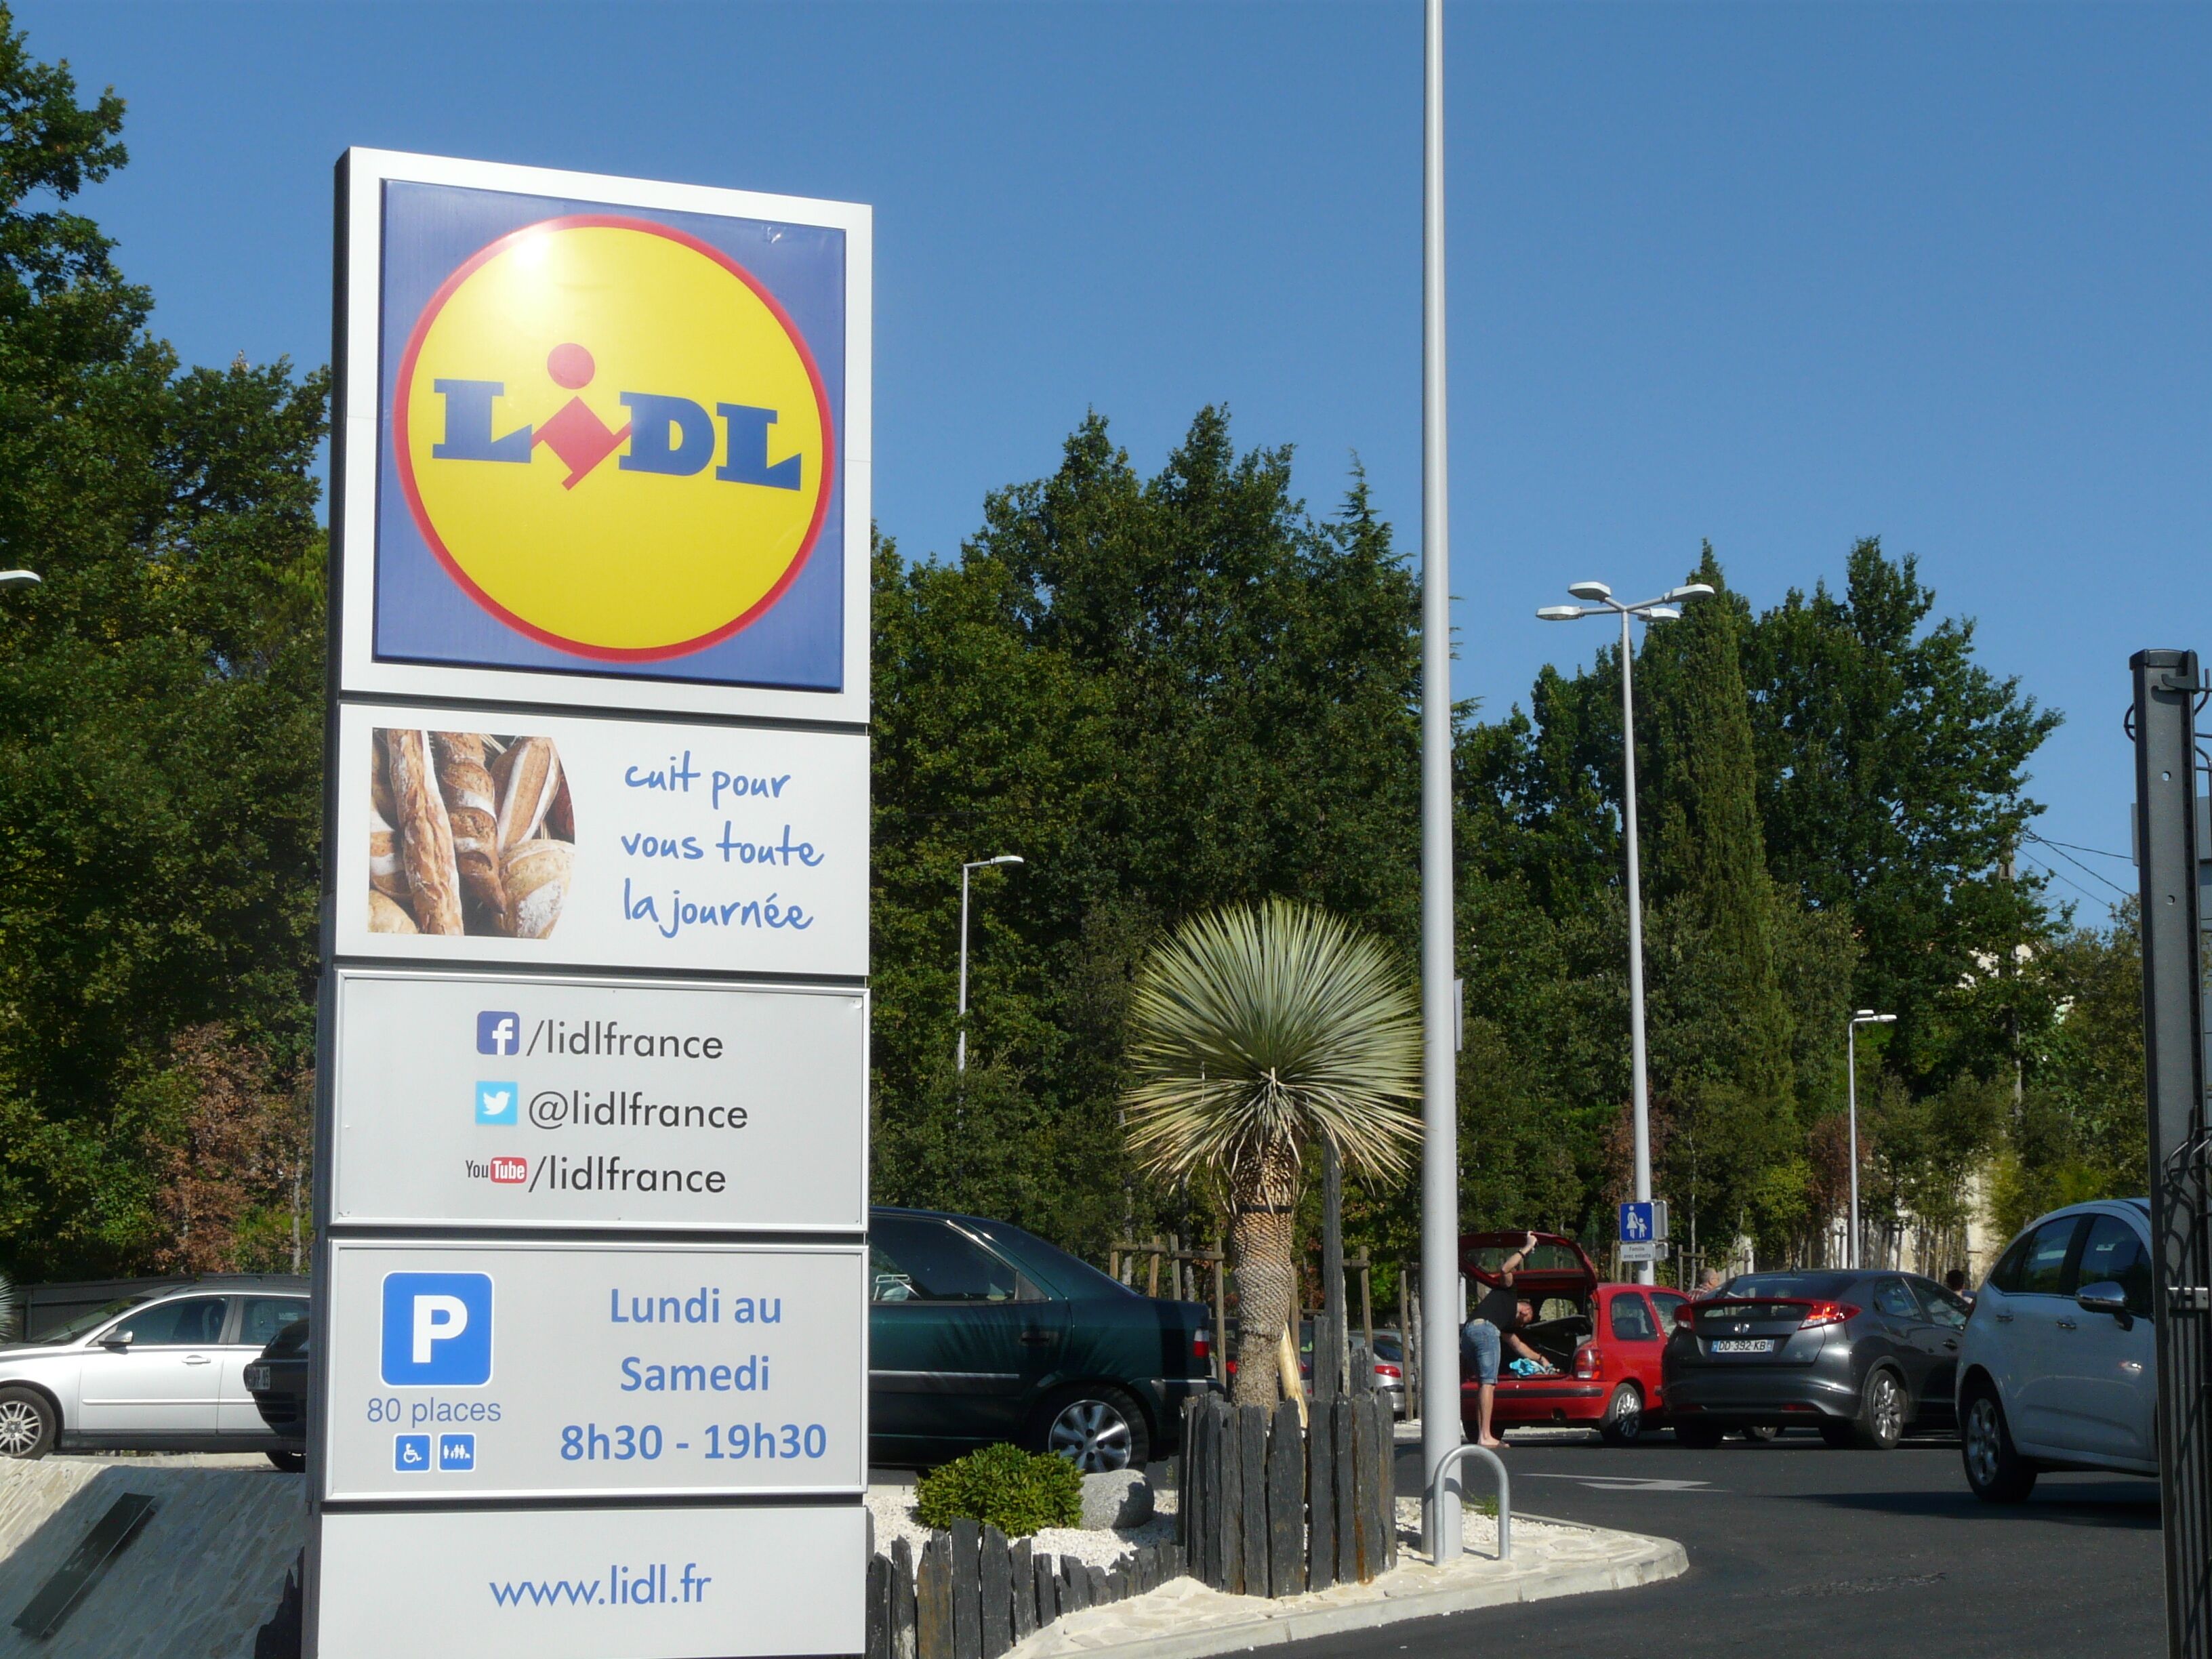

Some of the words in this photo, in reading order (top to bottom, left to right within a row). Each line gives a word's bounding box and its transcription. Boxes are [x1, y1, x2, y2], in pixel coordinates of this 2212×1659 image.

[625, 750, 701, 792] cuit
[712, 771, 791, 808] pour
[621, 834, 704, 860] vous
[716, 821, 825, 867] toute
[658, 890, 814, 939] journée
[527, 1020, 723, 1059] /lidlfrance
[529, 1090, 748, 1130] @lidlfrance
[528, 1155, 726, 1193] /lidlfrance
[611, 1287, 720, 1324] Lundi
[734, 1297, 781, 1324] au
[620, 1355, 769, 1392] Samedi
[367, 1397, 402, 1424] 80
[411, 1397, 502, 1429] places
[560, 1424, 663, 1461] 8h30
[705, 1422, 827, 1460] 19h30
[489, 1562, 712, 1606] www.lidl.fr
